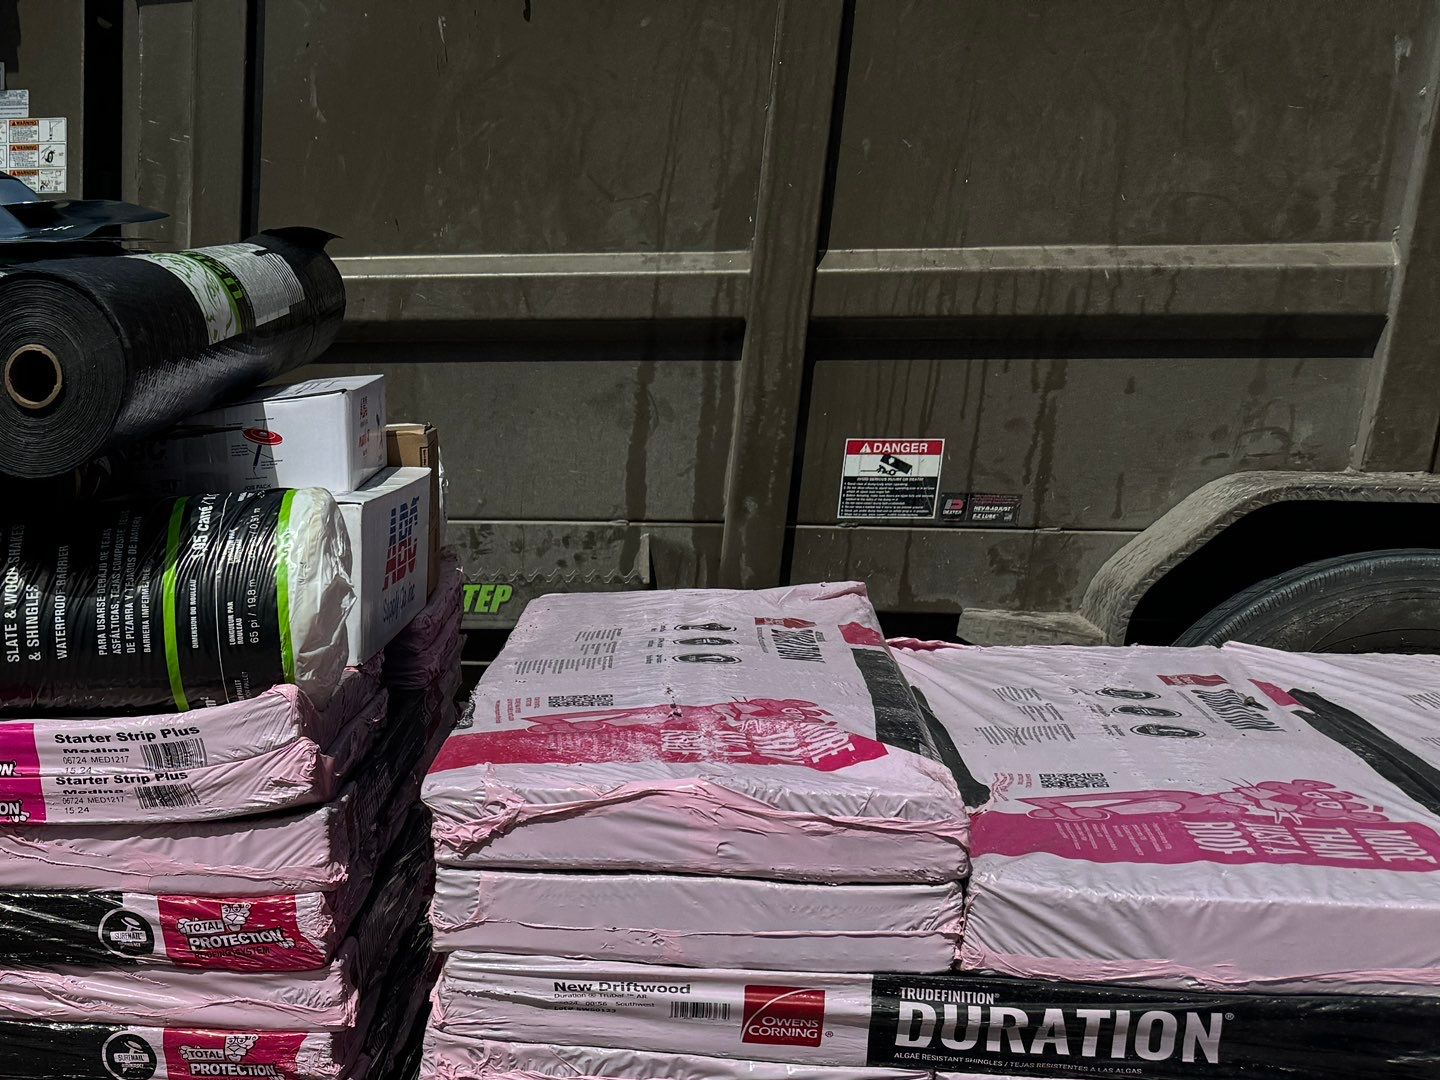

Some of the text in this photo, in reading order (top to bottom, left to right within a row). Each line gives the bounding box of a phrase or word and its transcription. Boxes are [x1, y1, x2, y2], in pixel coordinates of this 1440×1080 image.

[873, 443, 928, 453] DANGER
[5, 566, 22, 663] SLATE & WOOD
[124, 598, 136, 640] PIZARRA
[26, 584, 42, 661] & SHINGLES
[54, 593, 68, 660] WATERPROOF
[96, 595, 108, 657] PARA USARSE
[55, 725, 200, 744] Starter Strip Plus
[90, 755, 129, 764] MED1217
[56, 771, 188, 785] Starter Strip Plus
[187, 921, 222, 932] TOTAL
[190, 929, 283, 948] PROTECTION
[553, 981, 691, 995] New Driftwood
[900, 987, 995, 1005] TRUDEFINITION
[762, 1016, 819, 1028] OWENS
[748, 1025, 818, 1039] CORNING
[894, 1001, 1222, 1064] DURATION
[189, 1049, 222, 1059] TOTAL
[894, 1052, 963, 1064] ALGAE RESISTANT
[190, 1063, 275, 1076] PROTECTION
